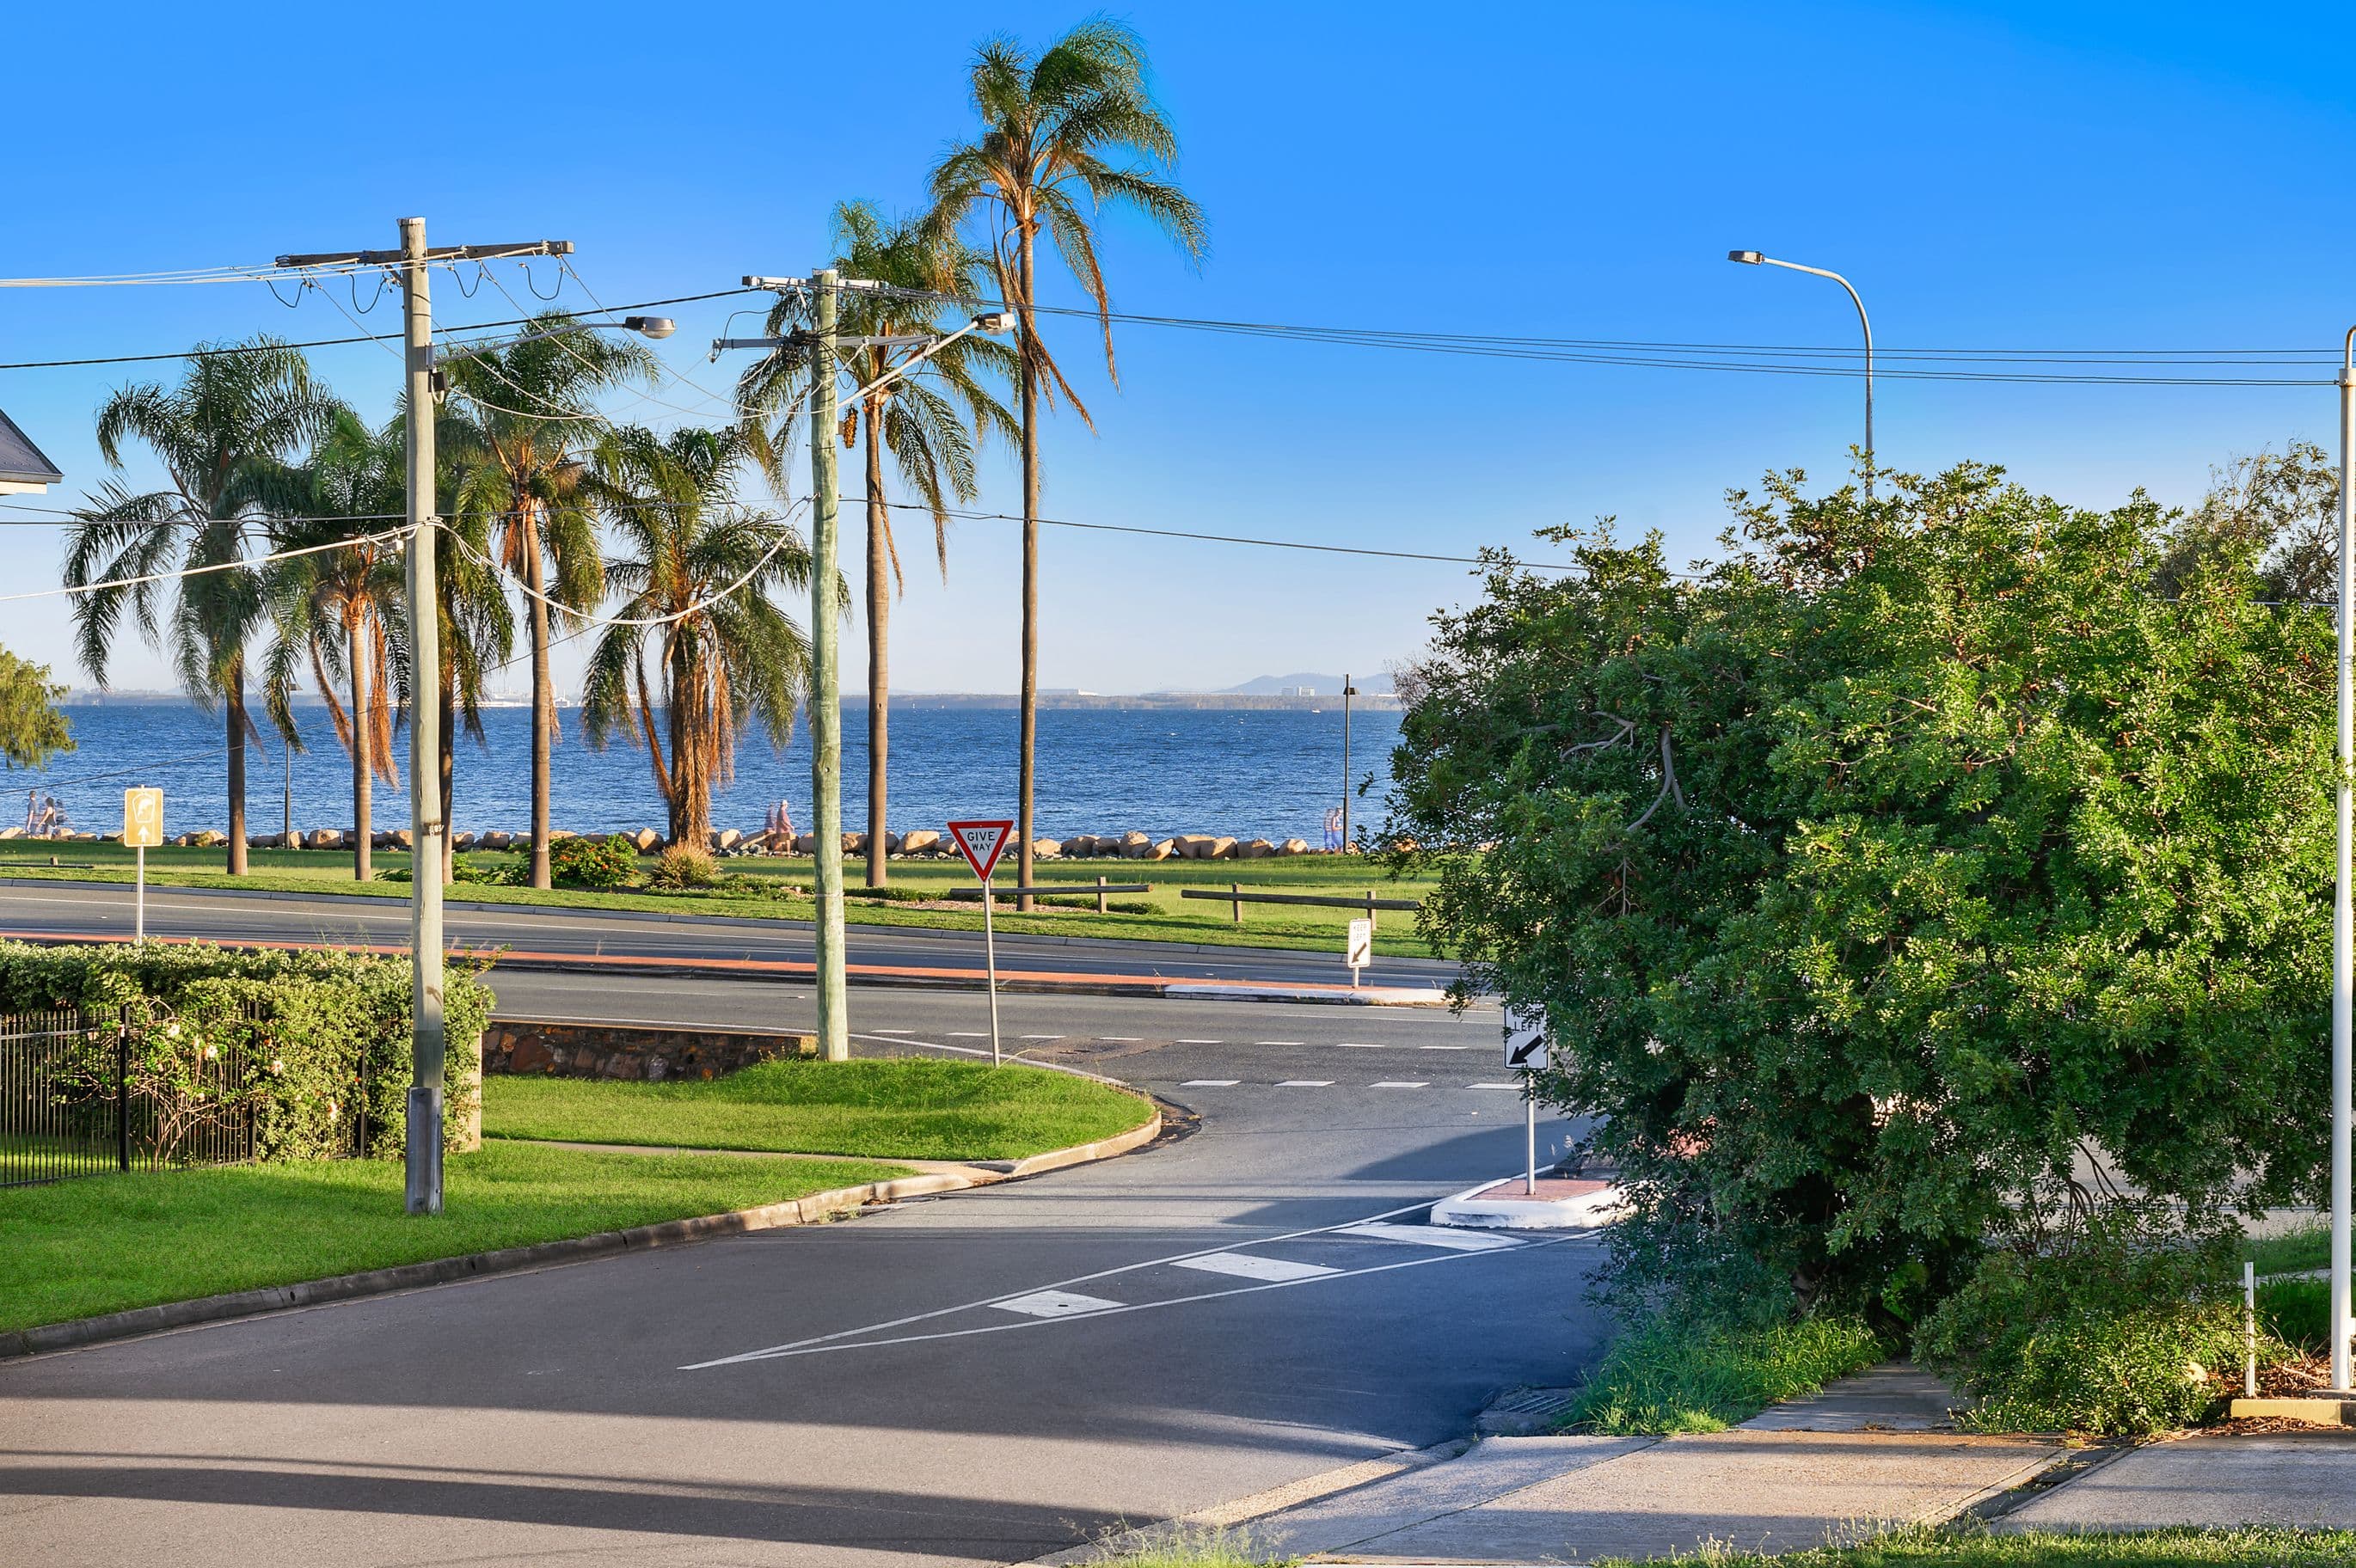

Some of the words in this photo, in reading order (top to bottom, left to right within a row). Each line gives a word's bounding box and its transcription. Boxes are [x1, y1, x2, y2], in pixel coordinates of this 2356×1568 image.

[967, 831, 995, 841] GIVE
[972, 842, 991, 851] WAY
[1514, 1021, 1541, 1032] LEFT
